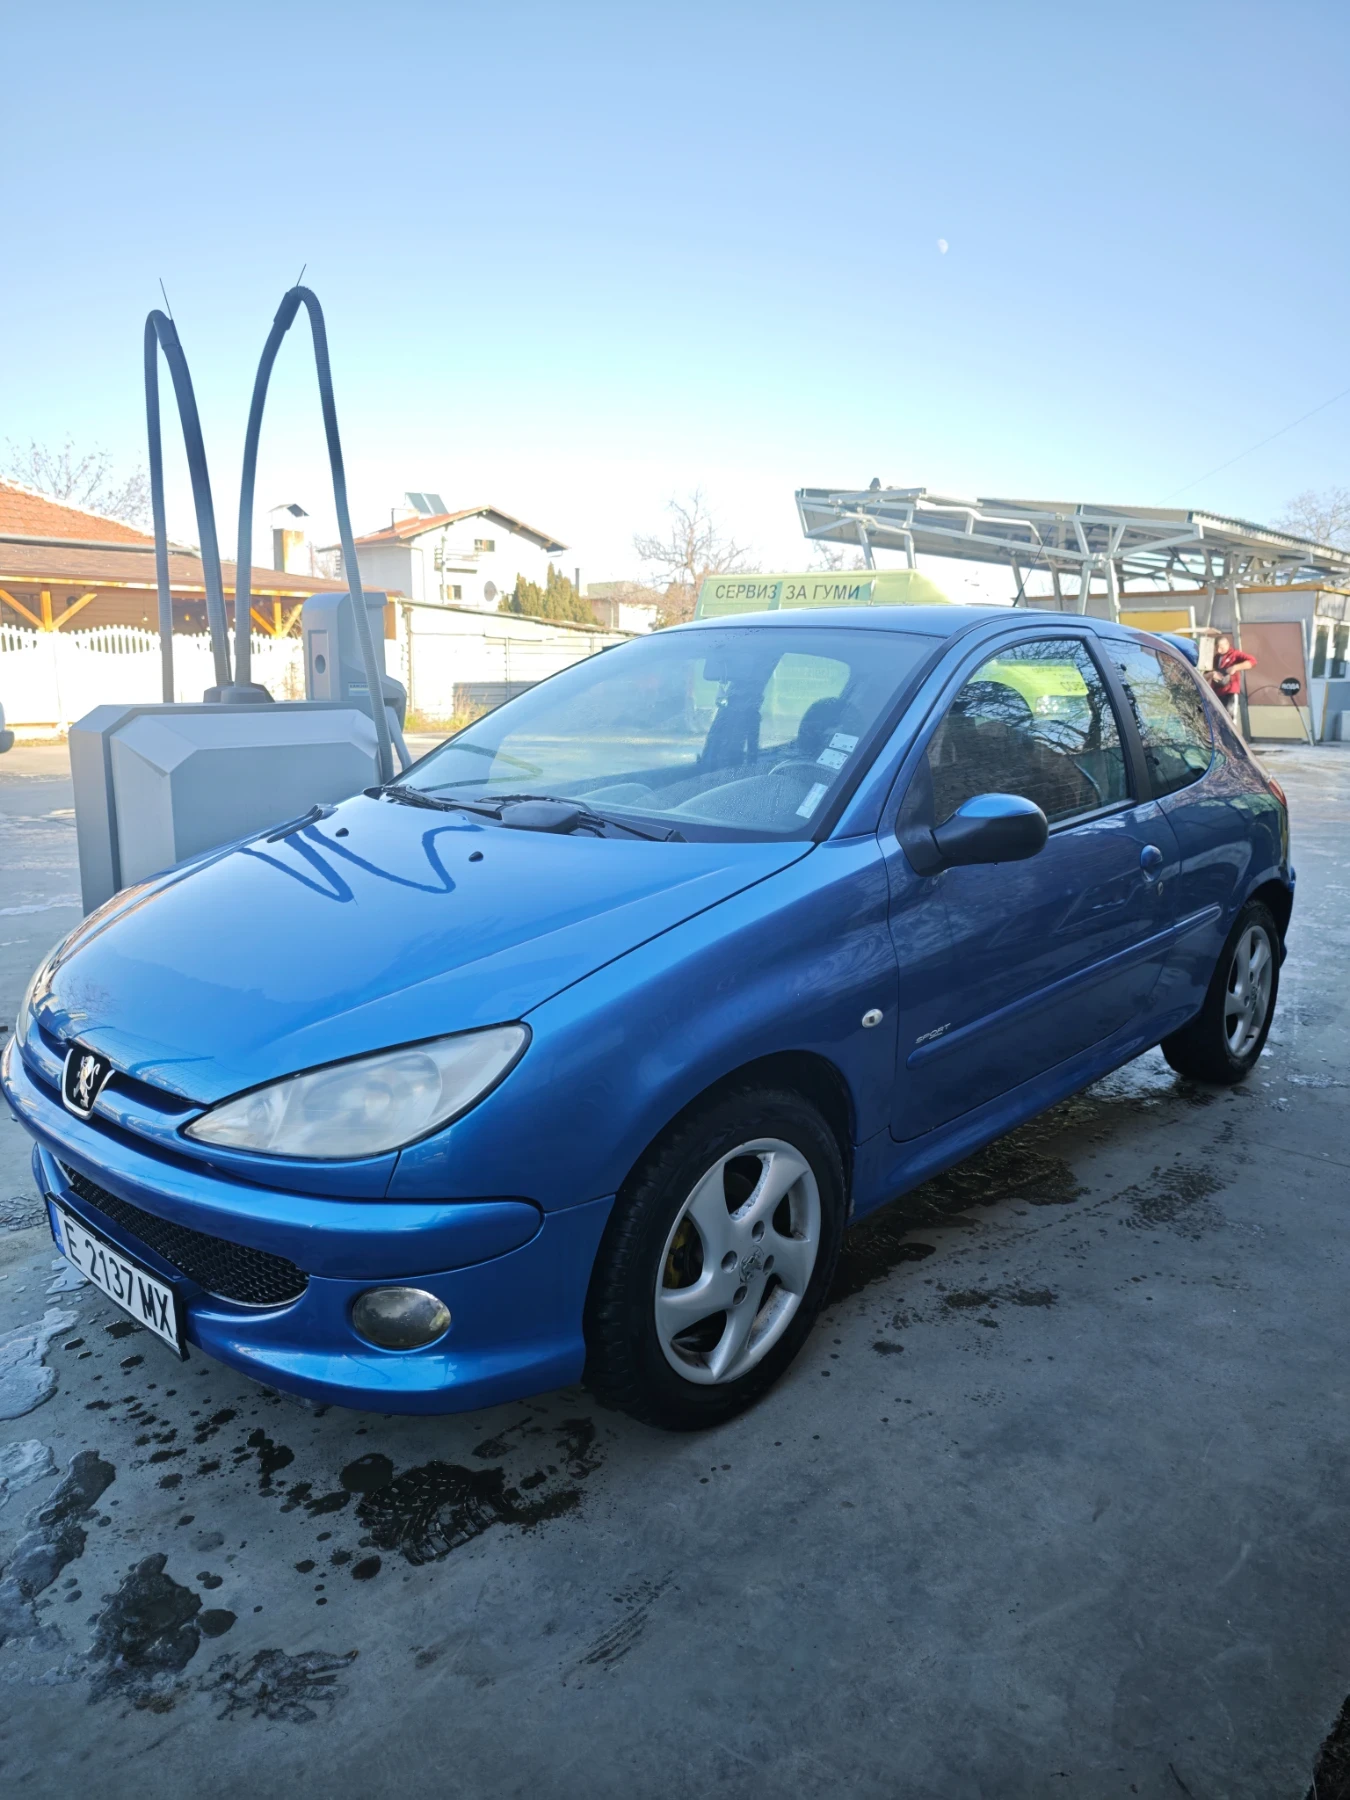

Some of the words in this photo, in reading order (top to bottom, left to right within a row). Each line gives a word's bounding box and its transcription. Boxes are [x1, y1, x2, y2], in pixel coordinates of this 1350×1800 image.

[715, 584, 778, 600] СЕРВИЗ
[785, 584, 808, 600] ЗА
[813, 584, 861, 600] ГУМИ
[64, 1219, 82, 1266] E
[85, 1238, 133, 1307] 2137
[138, 1275, 174, 1340] MX
